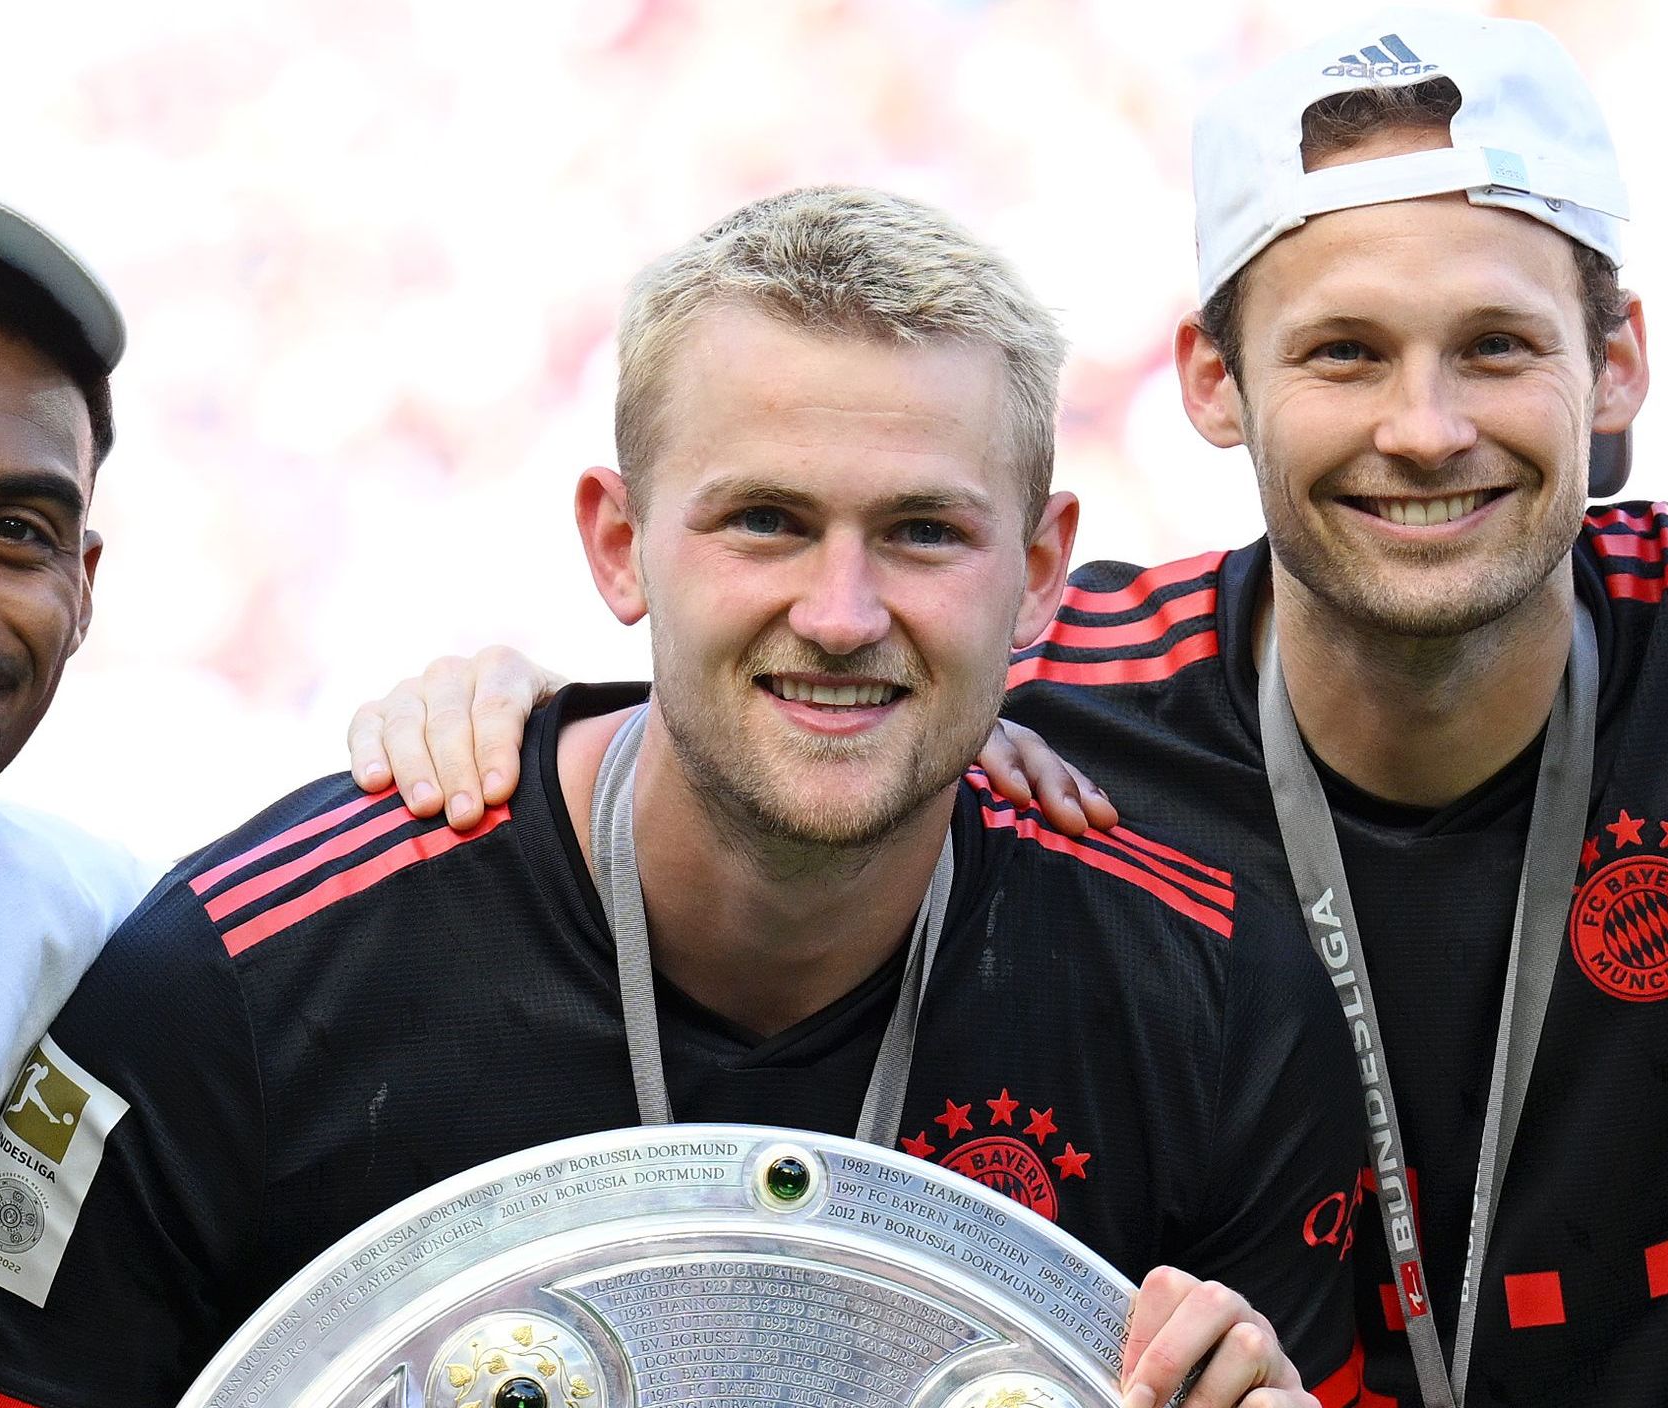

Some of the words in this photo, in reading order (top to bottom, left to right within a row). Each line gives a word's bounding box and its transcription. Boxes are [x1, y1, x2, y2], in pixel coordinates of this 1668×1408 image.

[1583, 895, 1607, 927] FC
[1311, 887, 1415, 1254] BUNDESLIGA
[512, 1168, 542, 1188] 1996
[544, 1161, 565, 1178] BV
[568, 1147, 642, 1172] BORUSSIA
[646, 1142, 737, 1158] DORTMUND
[840, 1155, 872, 1175] 1982
[877, 1165, 912, 1187] HSV
[922, 1180, 1008, 1229] HAMBURG
[1059, 1252, 1090, 1280] 1983
[1090, 1276, 1124, 1307] HSV
[971, 1150, 1048, 1202] BAYERN
[826, 1202, 857, 1221] 2012
[859, 1211, 881, 1228] BV
[883, 1217, 959, 1258] BORUSSIA
[959, 1247, 1047, 1308] DORTMUND
[1048, 1302, 1077, 1328] 2013
[1073, 1322, 1094, 1343] FC
[834, 1179, 865, 1198] 1997
[867, 1187, 889, 1205] FC
[889, 1194, 949, 1227] BAYERN
[951, 1215, 1031, 1268] MÜNCHEN
[1036, 1265, 1066, 1291] 1998
[1063, 1284, 1092, 1311] 1.FC
